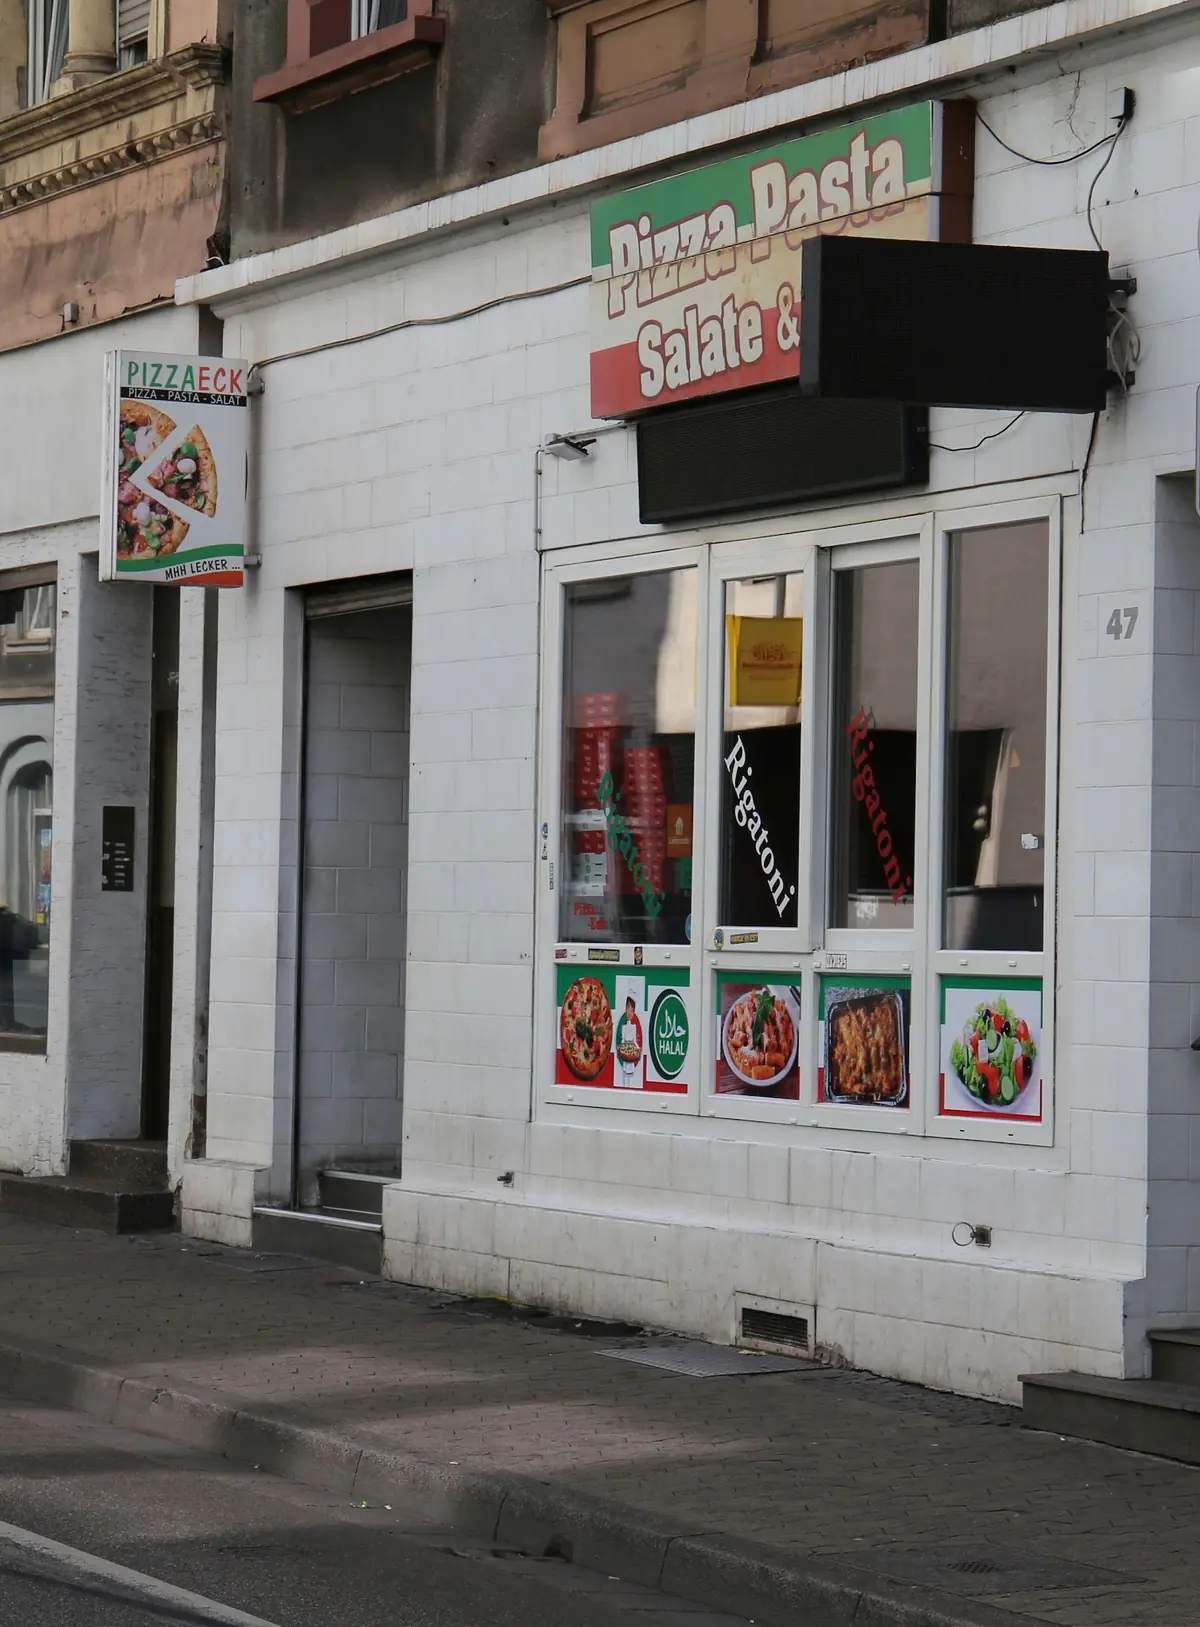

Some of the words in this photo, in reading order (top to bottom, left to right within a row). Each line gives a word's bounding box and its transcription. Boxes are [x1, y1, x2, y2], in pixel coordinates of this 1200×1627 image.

[607, 200, 738, 319] Pizza
[750, 128, 908, 263] Pasta
[637, 293, 765, 399] Salate
[776, 281, 801, 355] &
[127, 360, 243, 394] PIZZAECK
[128, 388, 157, 400] PIZZA
[168, 390, 200, 403] PASTA
[210, 393, 241, 406] SALAT
[165, 563, 187, 581] MHH
[190, 558, 228, 575] LECKER
[1106, 606, 1139, 640] 47
[845, 706, 913, 906] Rigatoni
[724, 735, 796, 918] Rigatoni
[659, 1009, 686, 1038] حلال
[659, 1040, 686, 1056] HALAL
